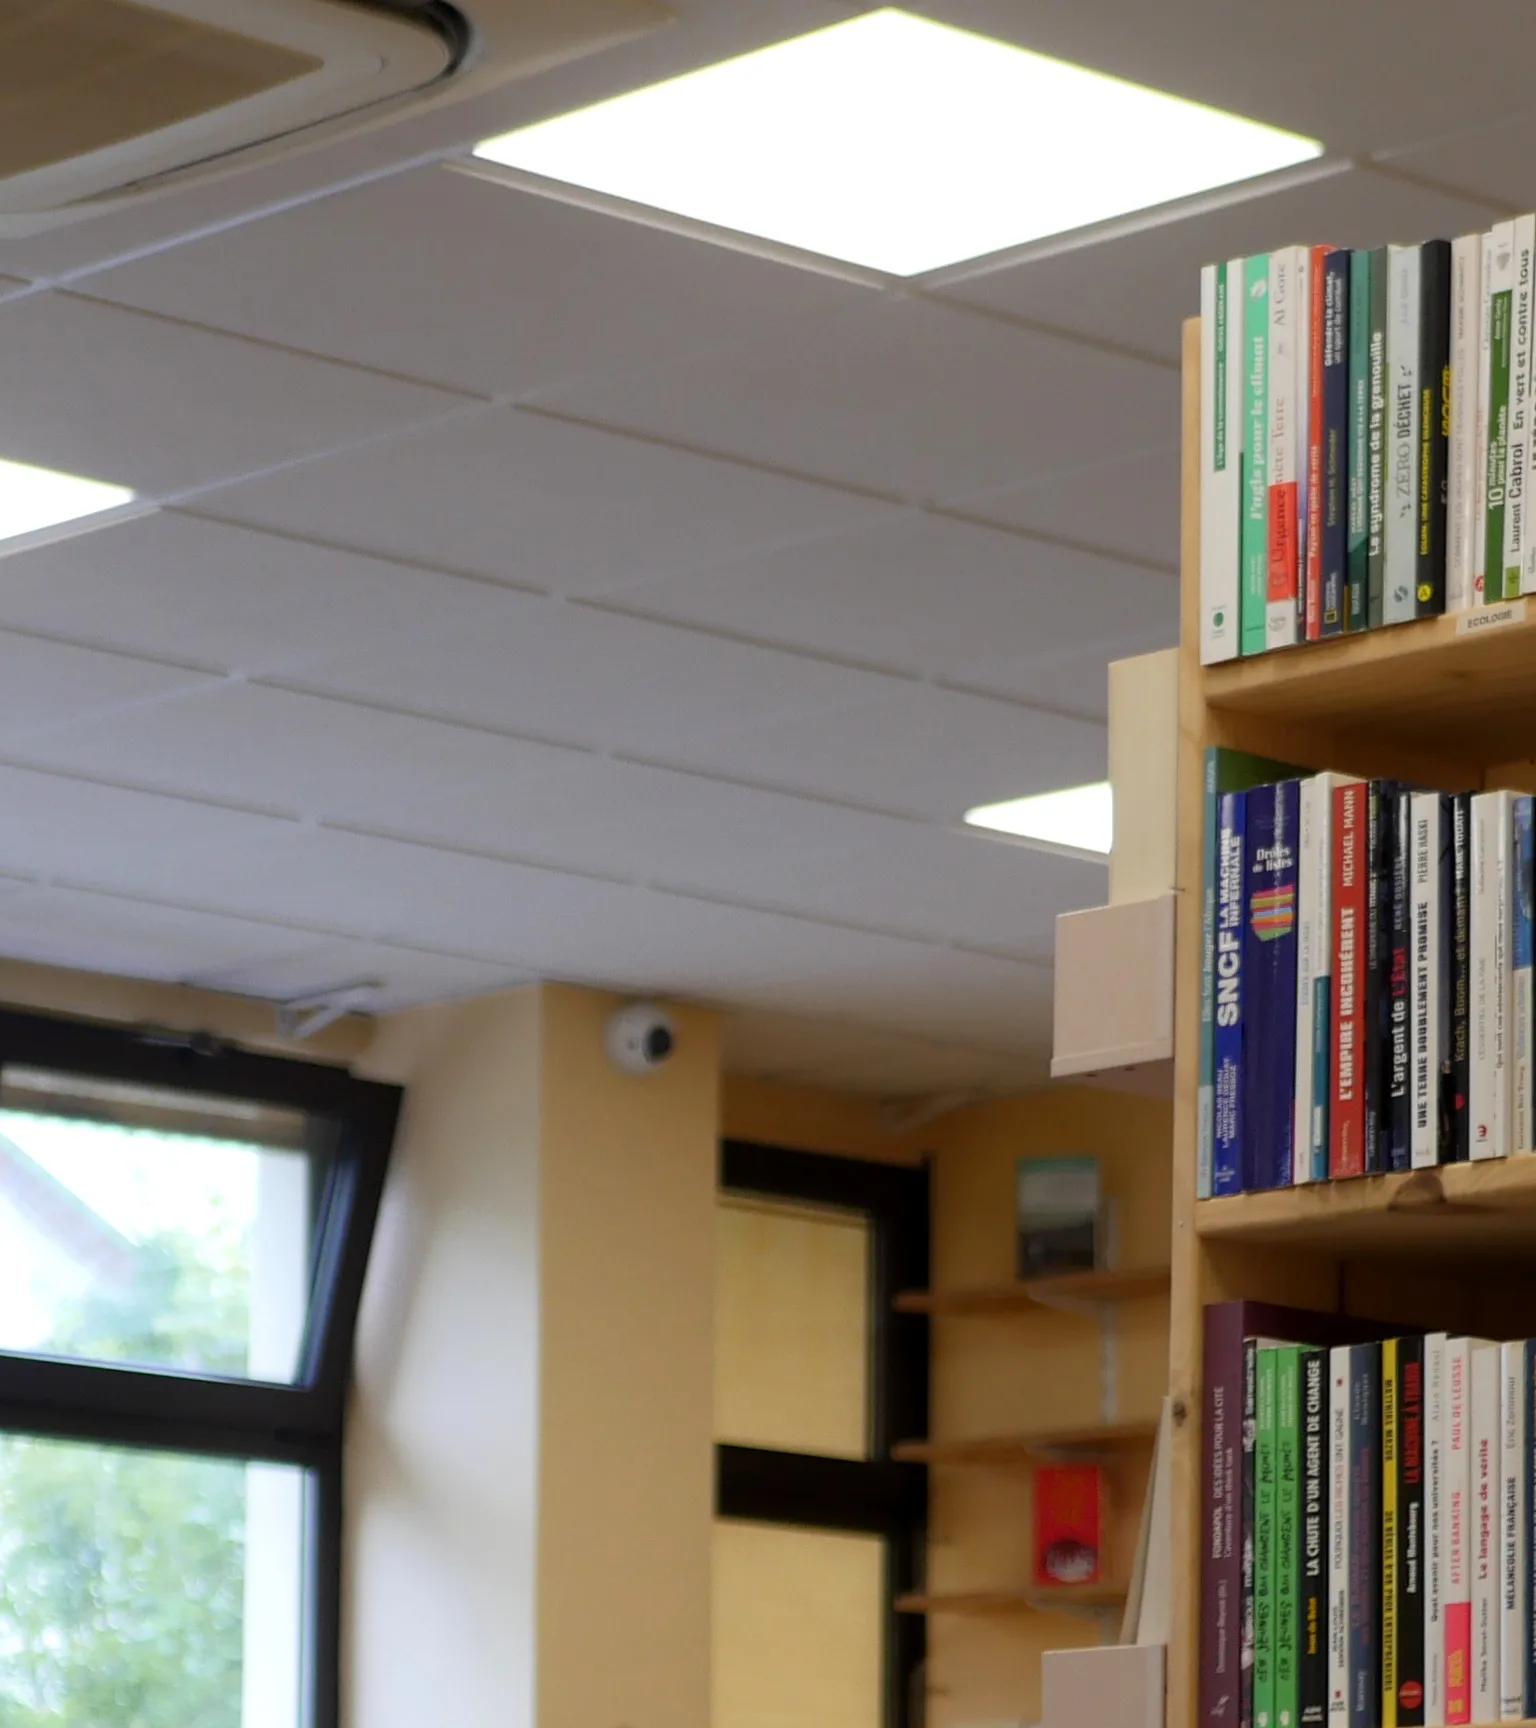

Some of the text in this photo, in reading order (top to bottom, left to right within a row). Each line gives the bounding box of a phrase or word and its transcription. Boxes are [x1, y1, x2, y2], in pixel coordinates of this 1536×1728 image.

[1369, 332, 1384, 555] Le syndrome de la grenouille
[1509, 248, 1530, 552] Laurent Cabrol En vert et contre tous
[1467, 610, 1513, 628] ECOLOGIE
[1217, 931, 1239, 1026] SNCF
[1338, 908, 1355, 1101] L'EMPIRE INCOHÉRENT
[1306, 1360, 1321, 1576] LA CHUTE D'UN AGENT DE CHANGE
